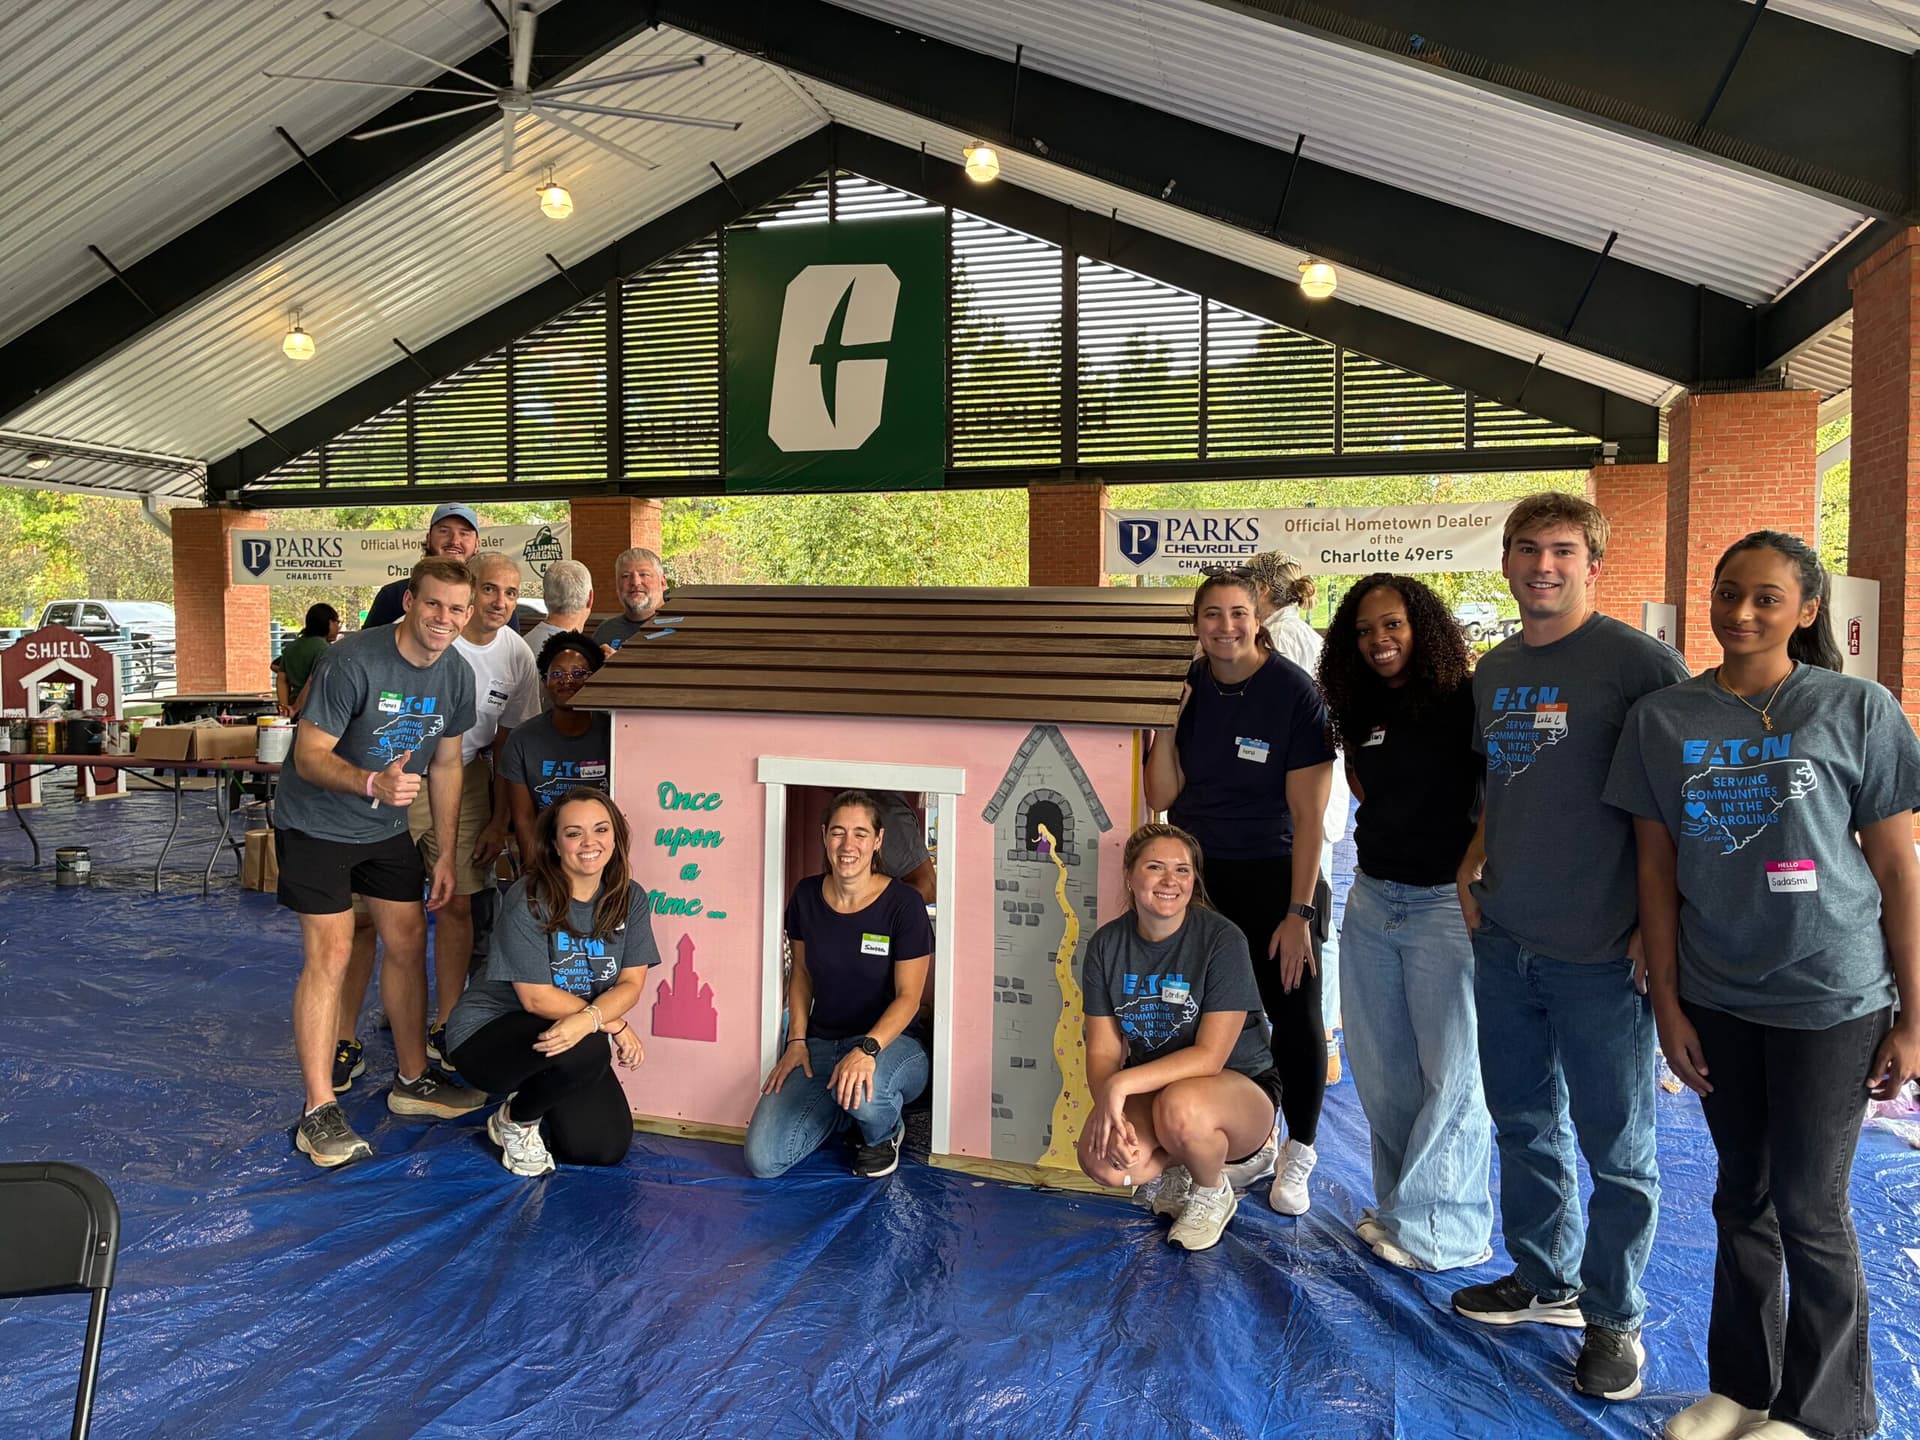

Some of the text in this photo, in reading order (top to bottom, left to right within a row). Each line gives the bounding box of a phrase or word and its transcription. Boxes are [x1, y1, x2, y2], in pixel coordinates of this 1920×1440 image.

[1166, 518, 1259, 541] PARKS
[1285, 514, 1491, 533] Official Hometown Dealer
[275, 537, 343, 557] PARKS
[361, 538, 400, 550] Official
[480, 536, 504, 547] aler
[1128, 524, 1151, 555] P
[1370, 534, 1403, 544] of the
[248, 541, 266, 568] P
[525, 543, 561, 553] ALUMNI
[527, 551, 562, 560] TAILGATE
[1165, 544, 1258, 554] CHEVROLET
[1321, 548, 1453, 563] Charlotte 49ers
[275, 560, 343, 568] CHEVROLET
[1851, 625, 1859, 654] FIRE
[25, 641, 92, 660] S.H.I.E.L.D.
[1492, 686, 1560, 711] EATON
[1683, 733, 1792, 765] EATON
[1713, 774, 1768, 788] SERVING
[658, 781, 723, 811] Once
[1687, 786, 1777, 800] COMMUNITIES
[1721, 801, 1763, 812] IN THE
[1710, 813, 1779, 827] CAROLINAS
[655, 826, 724, 857] upon
[680, 863, 701, 881] a
